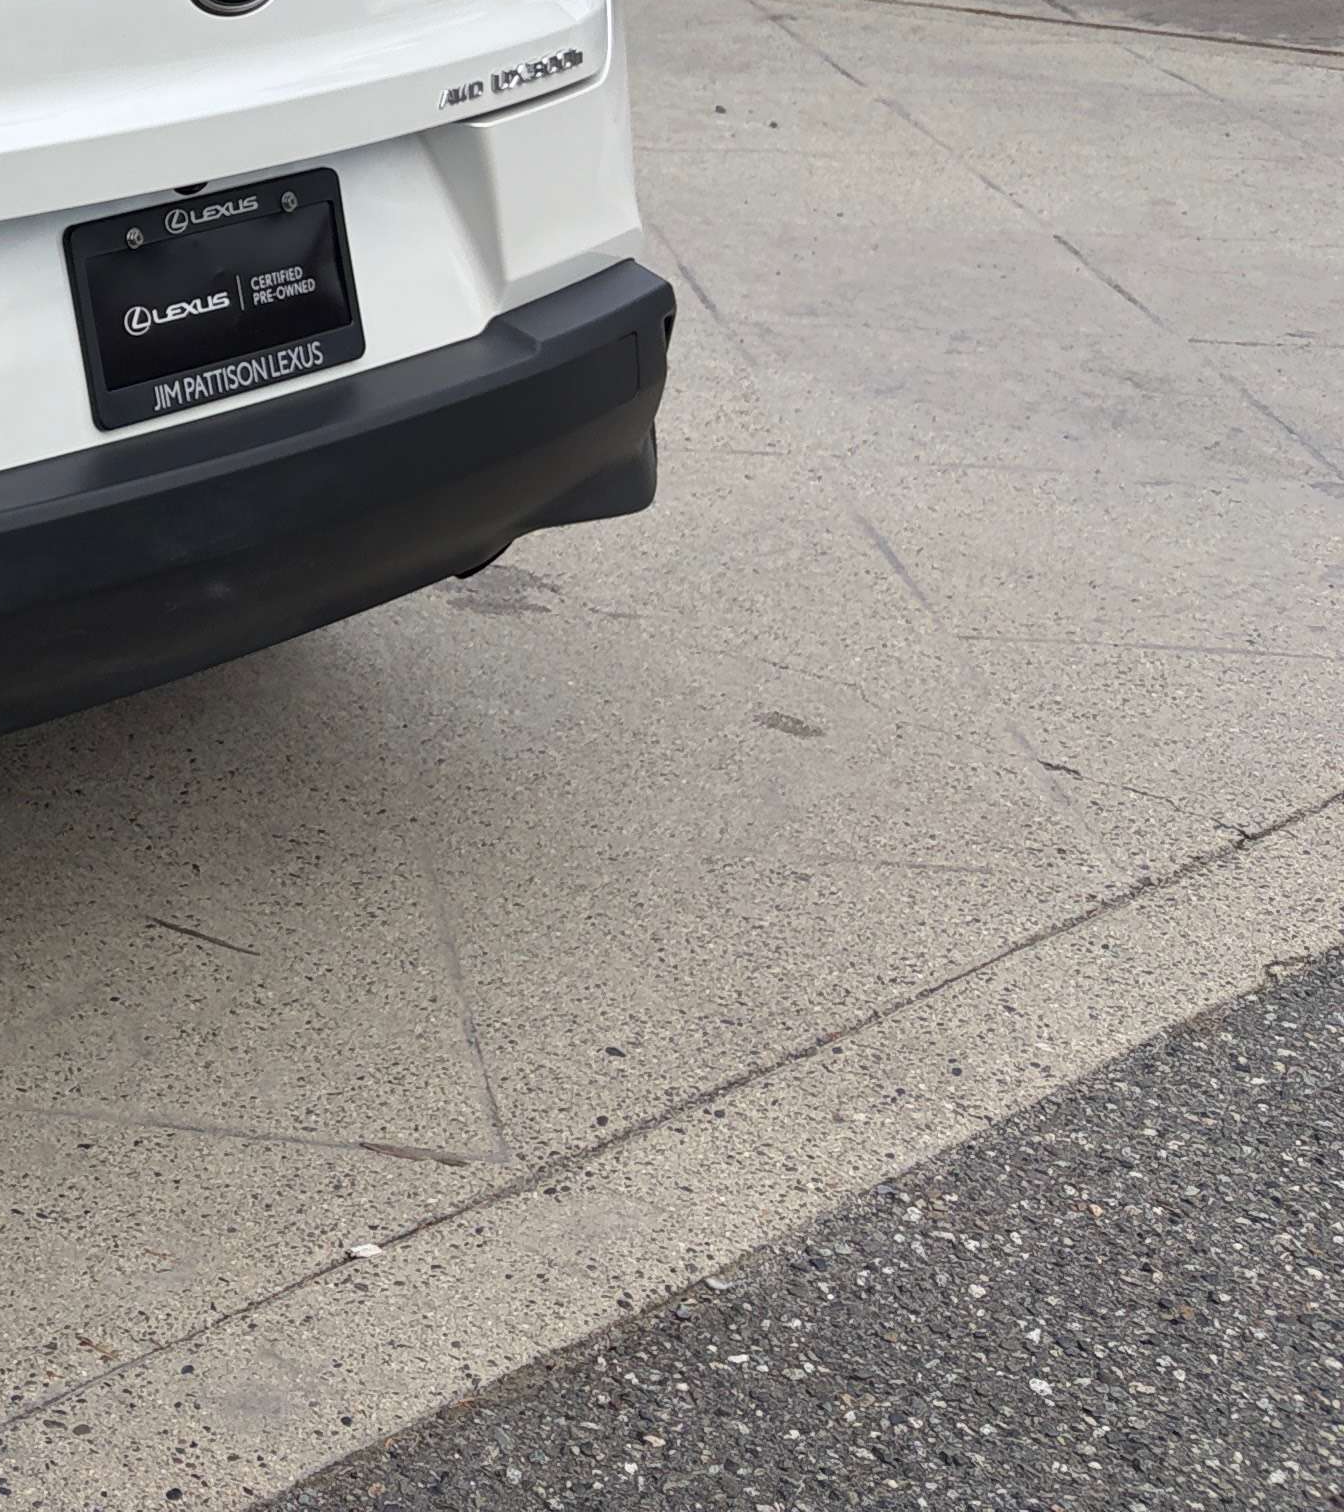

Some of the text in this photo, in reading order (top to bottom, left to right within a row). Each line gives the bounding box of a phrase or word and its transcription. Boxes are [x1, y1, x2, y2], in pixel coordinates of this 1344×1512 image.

[191, 196, 258, 223] LEXUS
[250, 266, 303, 291] CERTIFIED
[252, 278, 316, 306] PRE-OWNED
[152, 292, 230, 324] LEXUS
[153, 341, 324, 411] JIM PATTISON LEXUS
